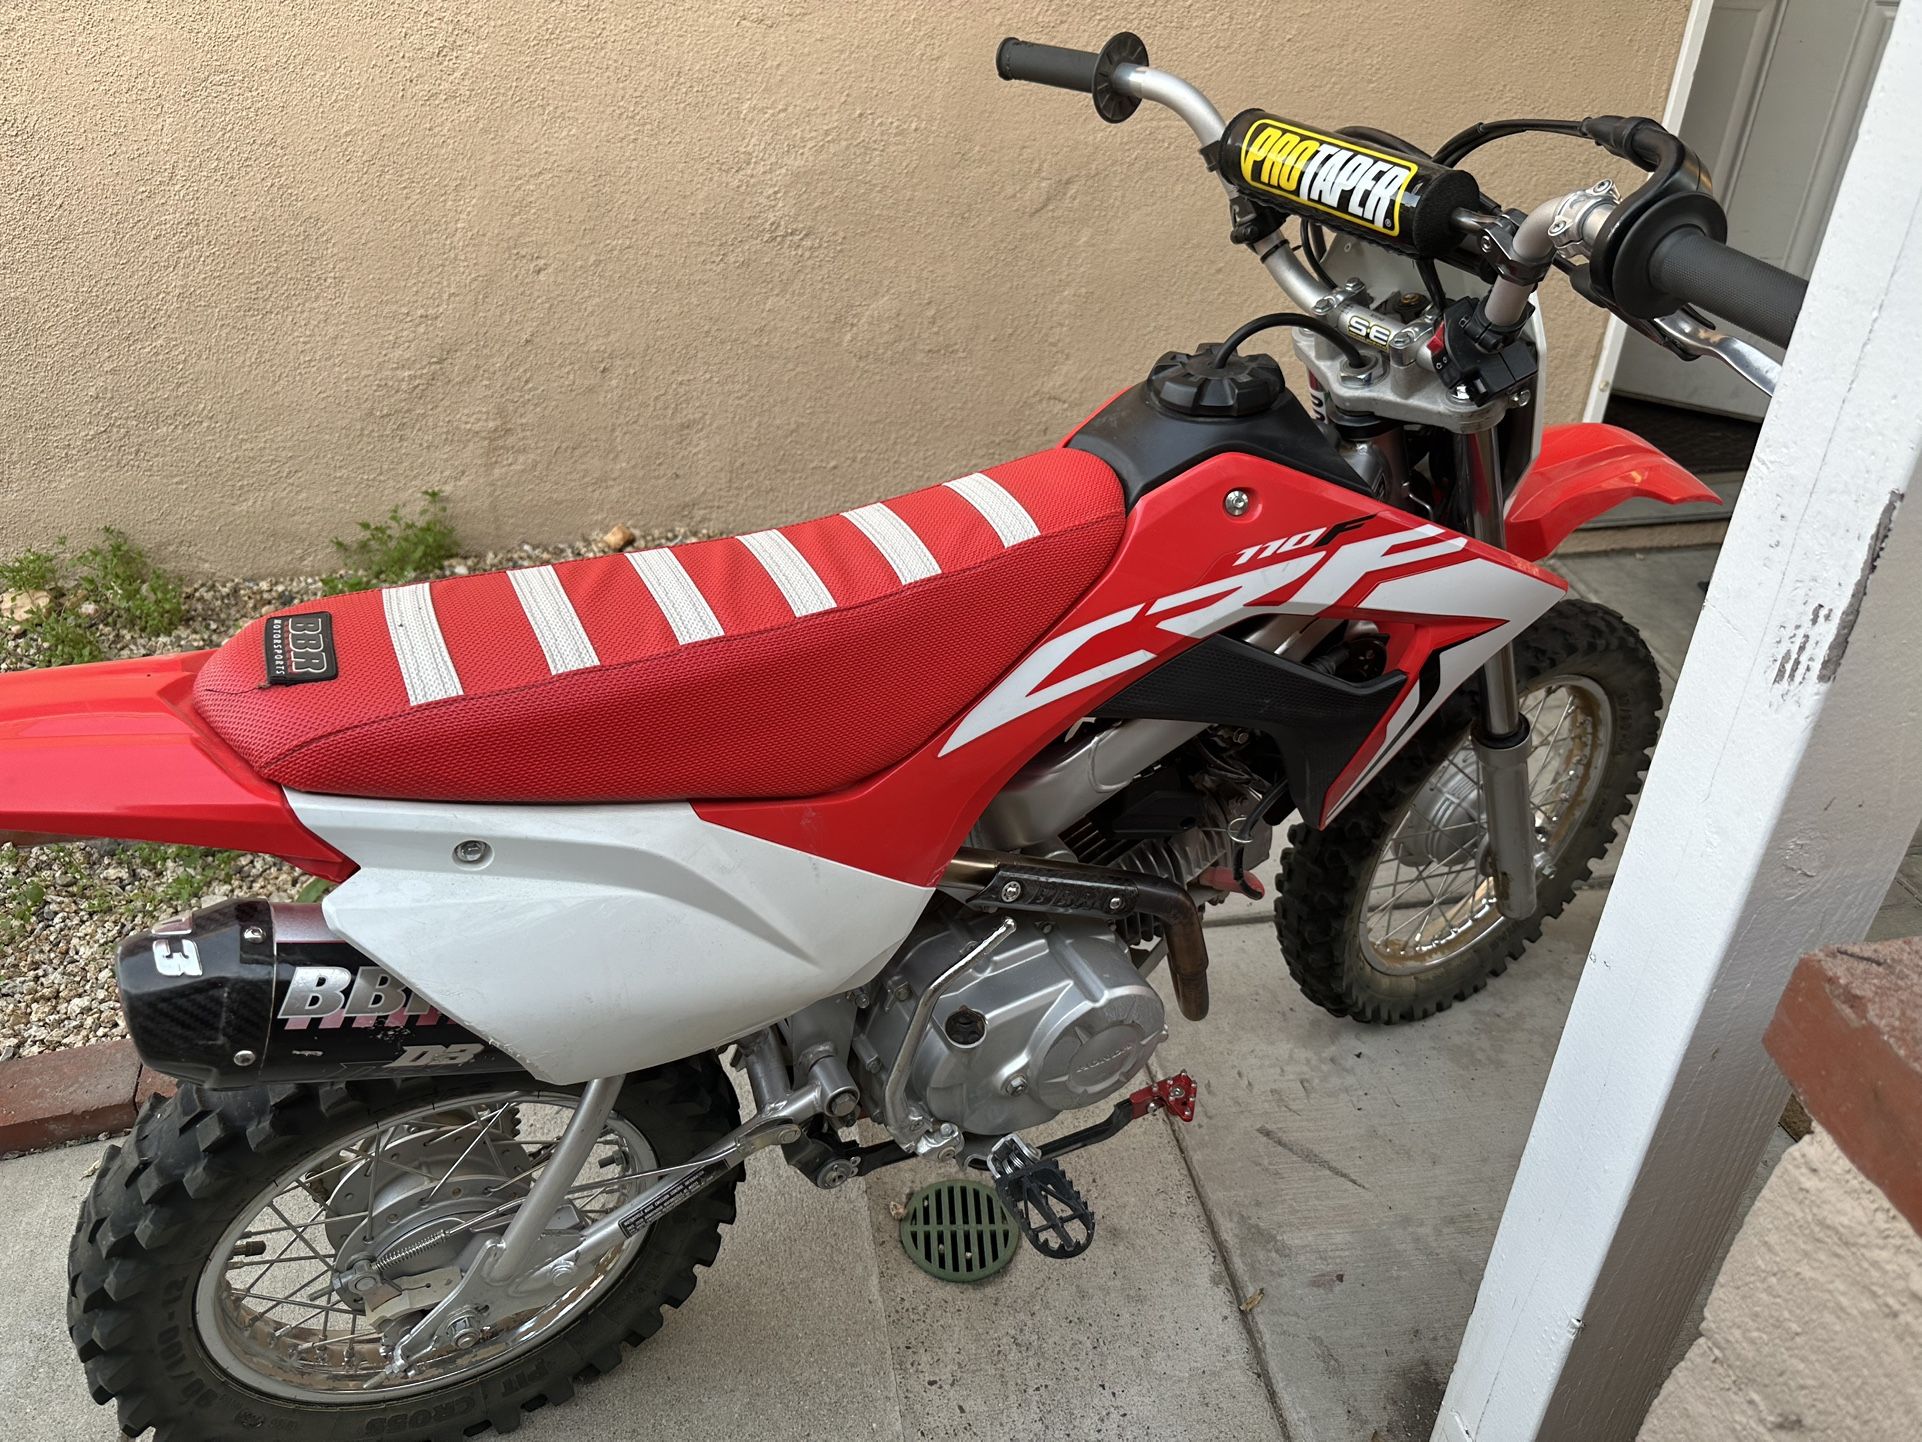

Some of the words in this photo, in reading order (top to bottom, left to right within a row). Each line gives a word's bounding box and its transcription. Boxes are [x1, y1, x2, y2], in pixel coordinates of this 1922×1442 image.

[272, 619, 286, 675] MOTORSPORTS
[288, 617, 327, 673] BBR
[278, 966, 433, 1019] BB
